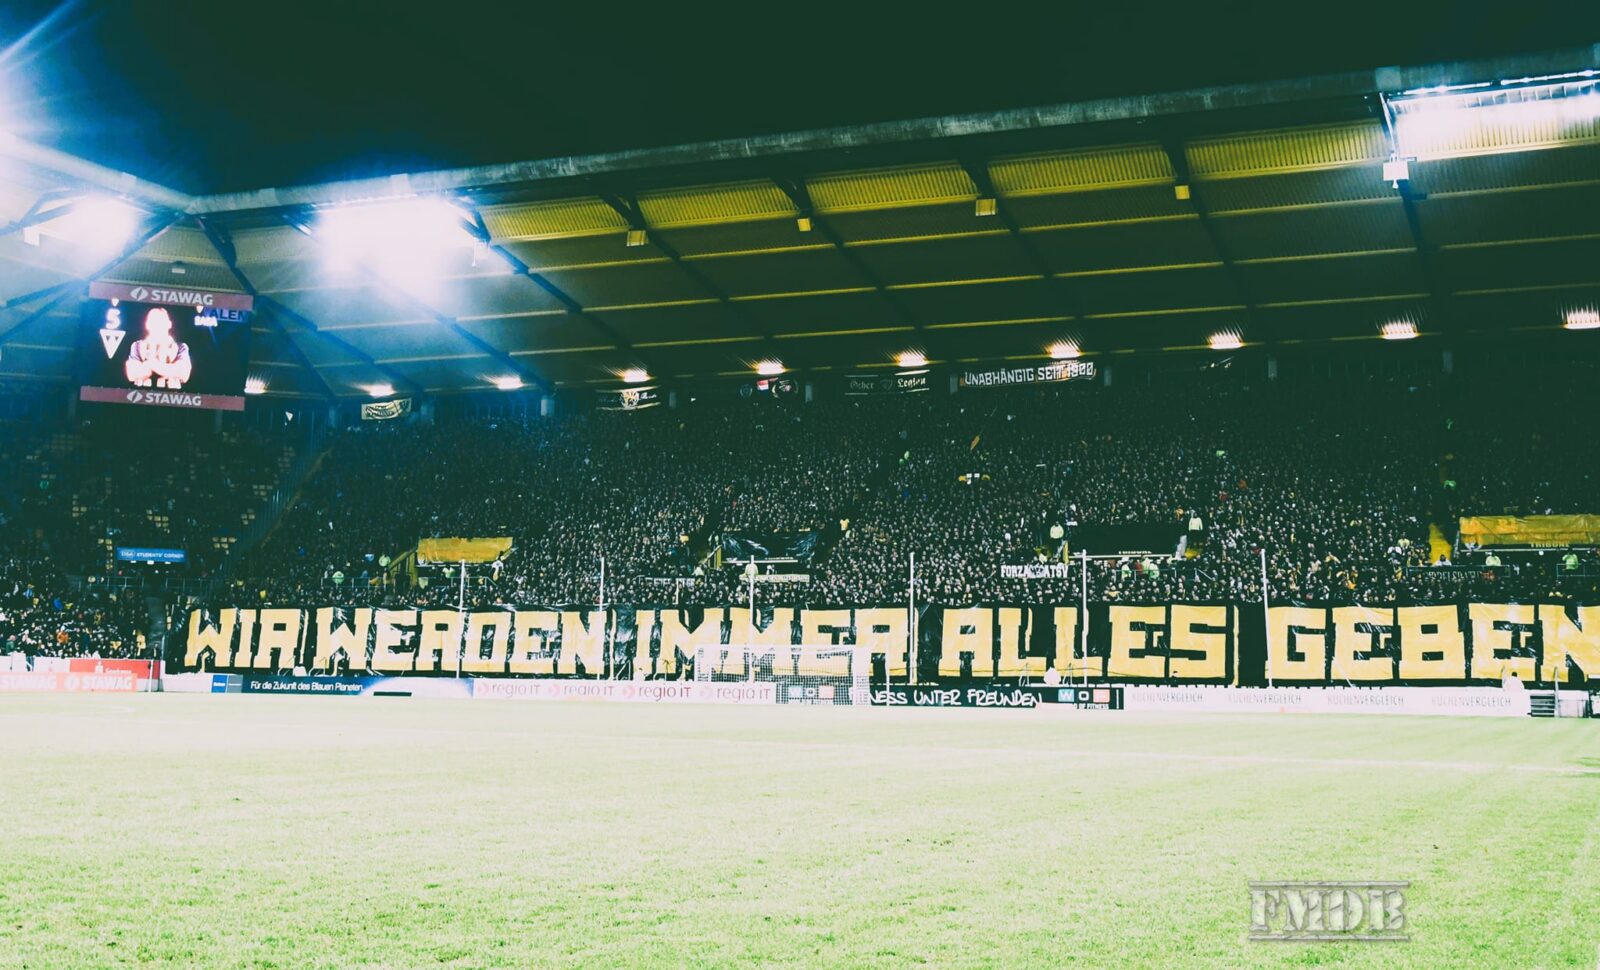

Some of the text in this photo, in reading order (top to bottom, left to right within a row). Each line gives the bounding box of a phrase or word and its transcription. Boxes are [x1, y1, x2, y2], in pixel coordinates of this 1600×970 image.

[151, 289, 213, 305] STAWAG
[965, 366, 1034, 385] UNABHÄNGIG
[1038, 364, 1064, 380] SEIT
[145, 392, 202, 406] STAWAG
[184, 603, 1600, 682] WIR WERDEN IMMER ALLES GEBEN
[250, 681, 261, 690] Für
[262, 682, 272, 690] die
[273, 681, 297, 690] Zukunft
[298, 682, 310, 690] des
[311, 682, 333, 691] Blauen
[491, 682, 527, 697] regio
[638, 683, 676, 701] regio
[914, 690, 961, 706] UNTER
[967, 690, 1043, 707] FREUNDEN
